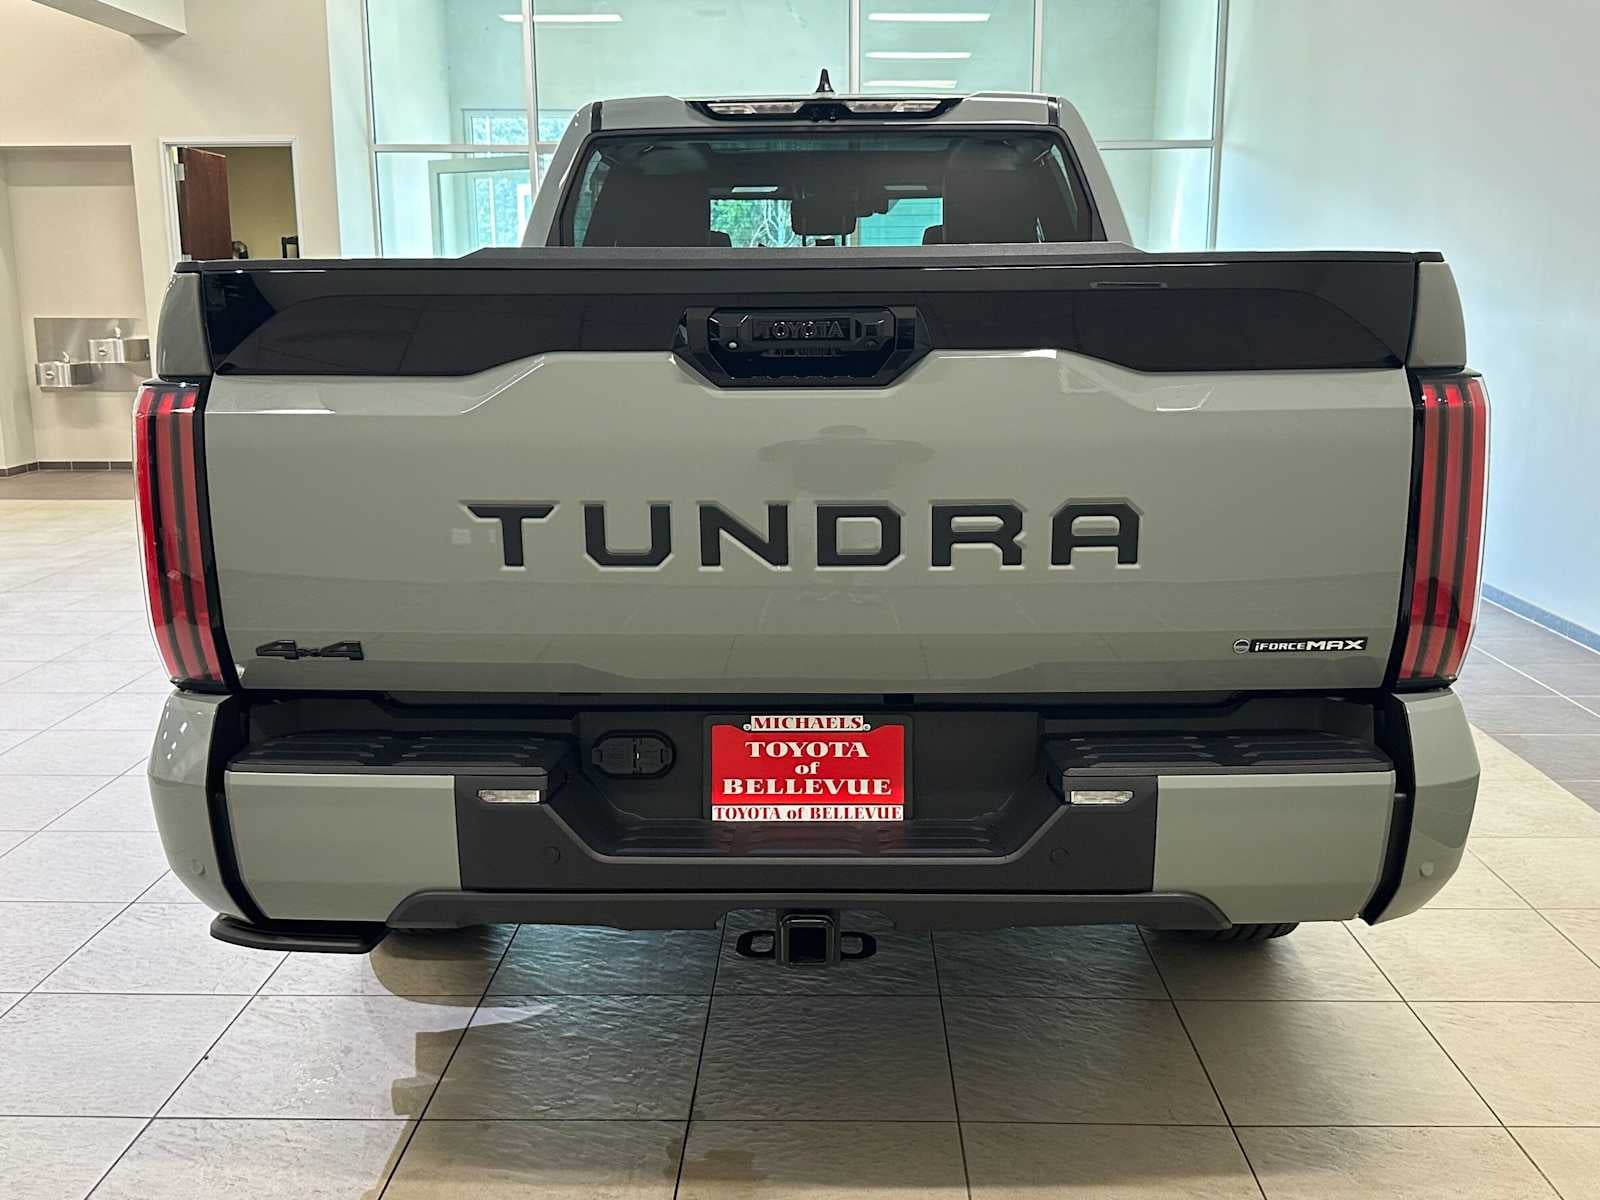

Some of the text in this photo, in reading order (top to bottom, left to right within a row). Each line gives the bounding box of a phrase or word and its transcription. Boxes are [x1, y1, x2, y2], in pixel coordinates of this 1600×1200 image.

[761, 319, 846, 340] TOYOTA
[464, 500, 1143, 569] TUNDRA
[753, 717, 862, 729] MICHAELS
[745, 741, 870, 758] TOYOTA
[794, 761, 821, 775] of
[722, 778, 892, 795] BELLEVUE
[714, 807, 902, 819] TOYOTA of BELLEVUE
